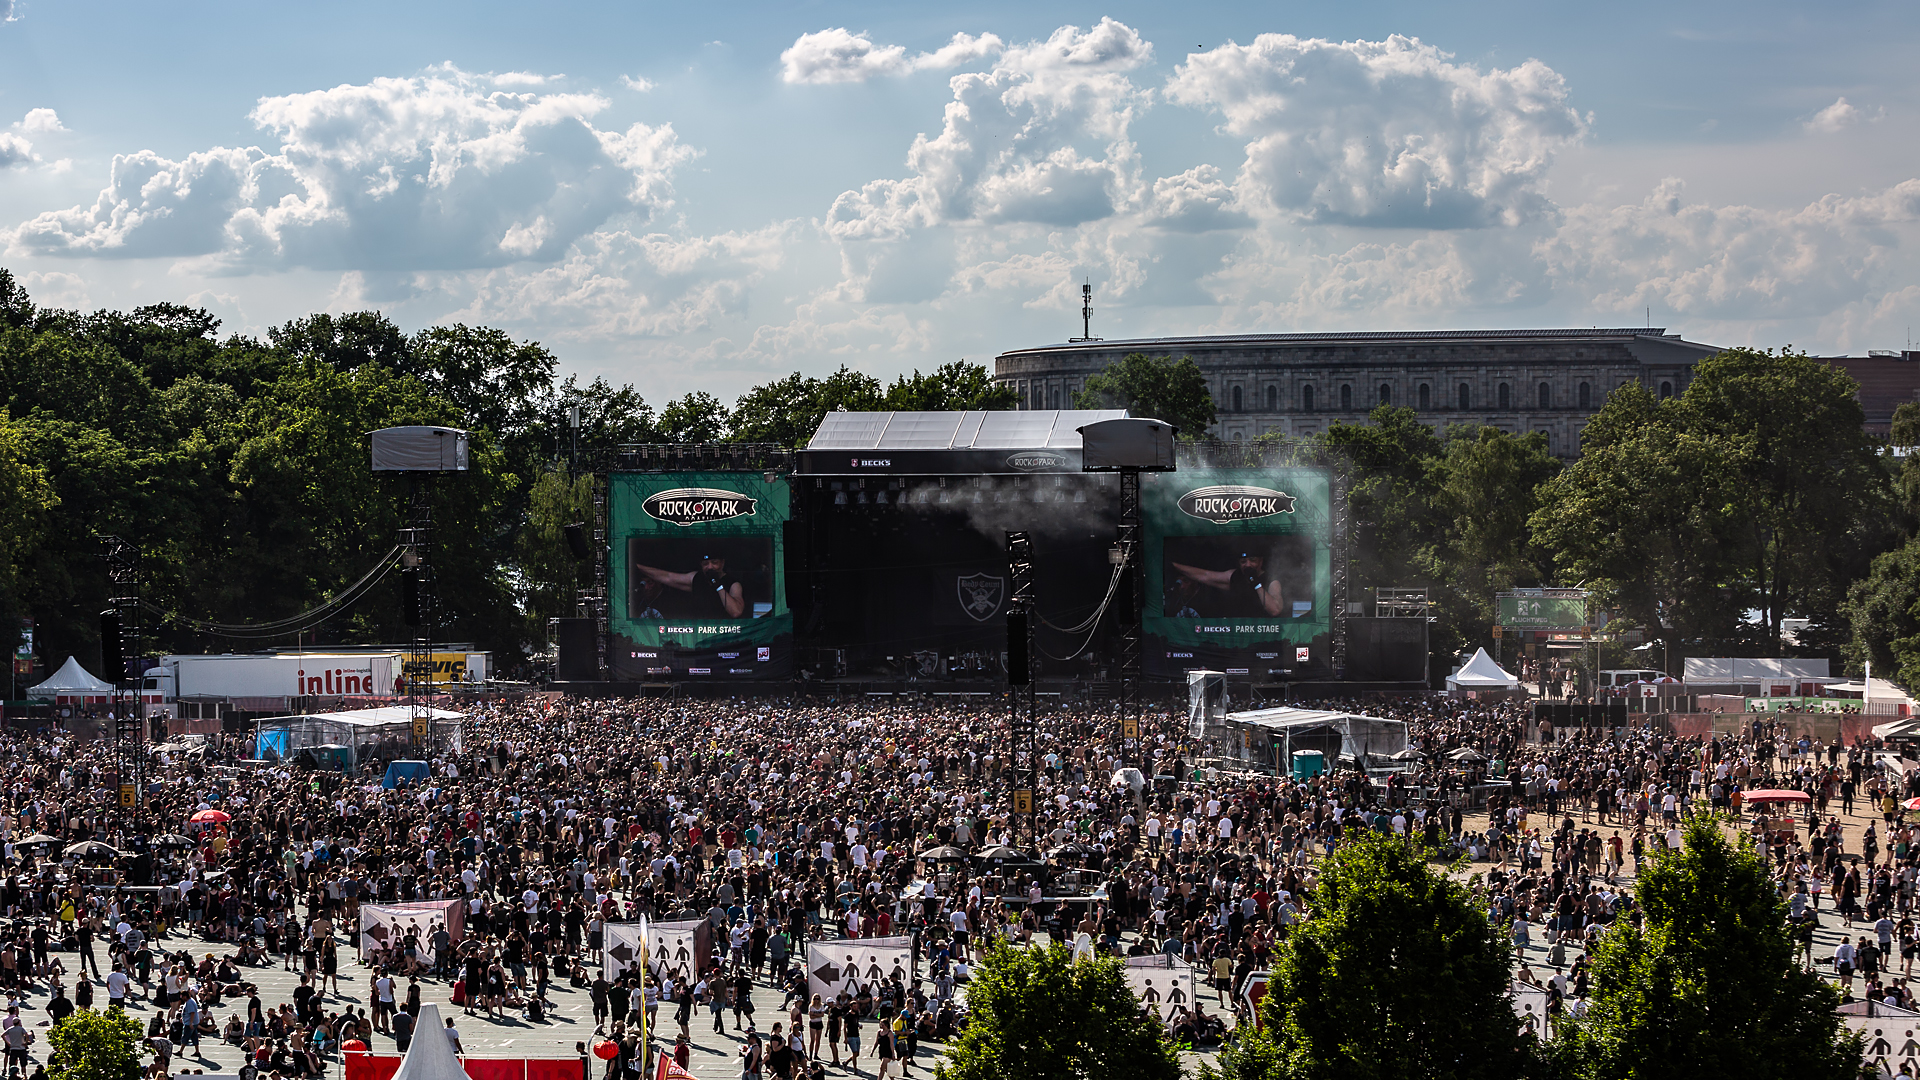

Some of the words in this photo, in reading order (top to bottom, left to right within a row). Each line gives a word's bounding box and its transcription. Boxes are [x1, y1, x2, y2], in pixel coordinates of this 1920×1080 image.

[1014, 458, 1033, 467] ROCK
[1038, 458, 1056, 466] PARK
[658, 500, 694, 516] ROCK
[705, 500, 739, 516] PARK
[1195, 498, 1230, 513] ROCK
[1242, 498, 1277, 513] PARK
[698, 626, 717, 634] PARK
[719, 626, 741, 634] STAGE
[1235, 625, 1255, 633] PARK
[1257, 625, 1279, 633] STAGE
[297, 669, 372, 694] inline
[417, 725, 423, 733] 3
[1127, 727, 1134, 735] 4
[123, 793, 131, 803] 5
[1019, 799, 1027, 809] 6
